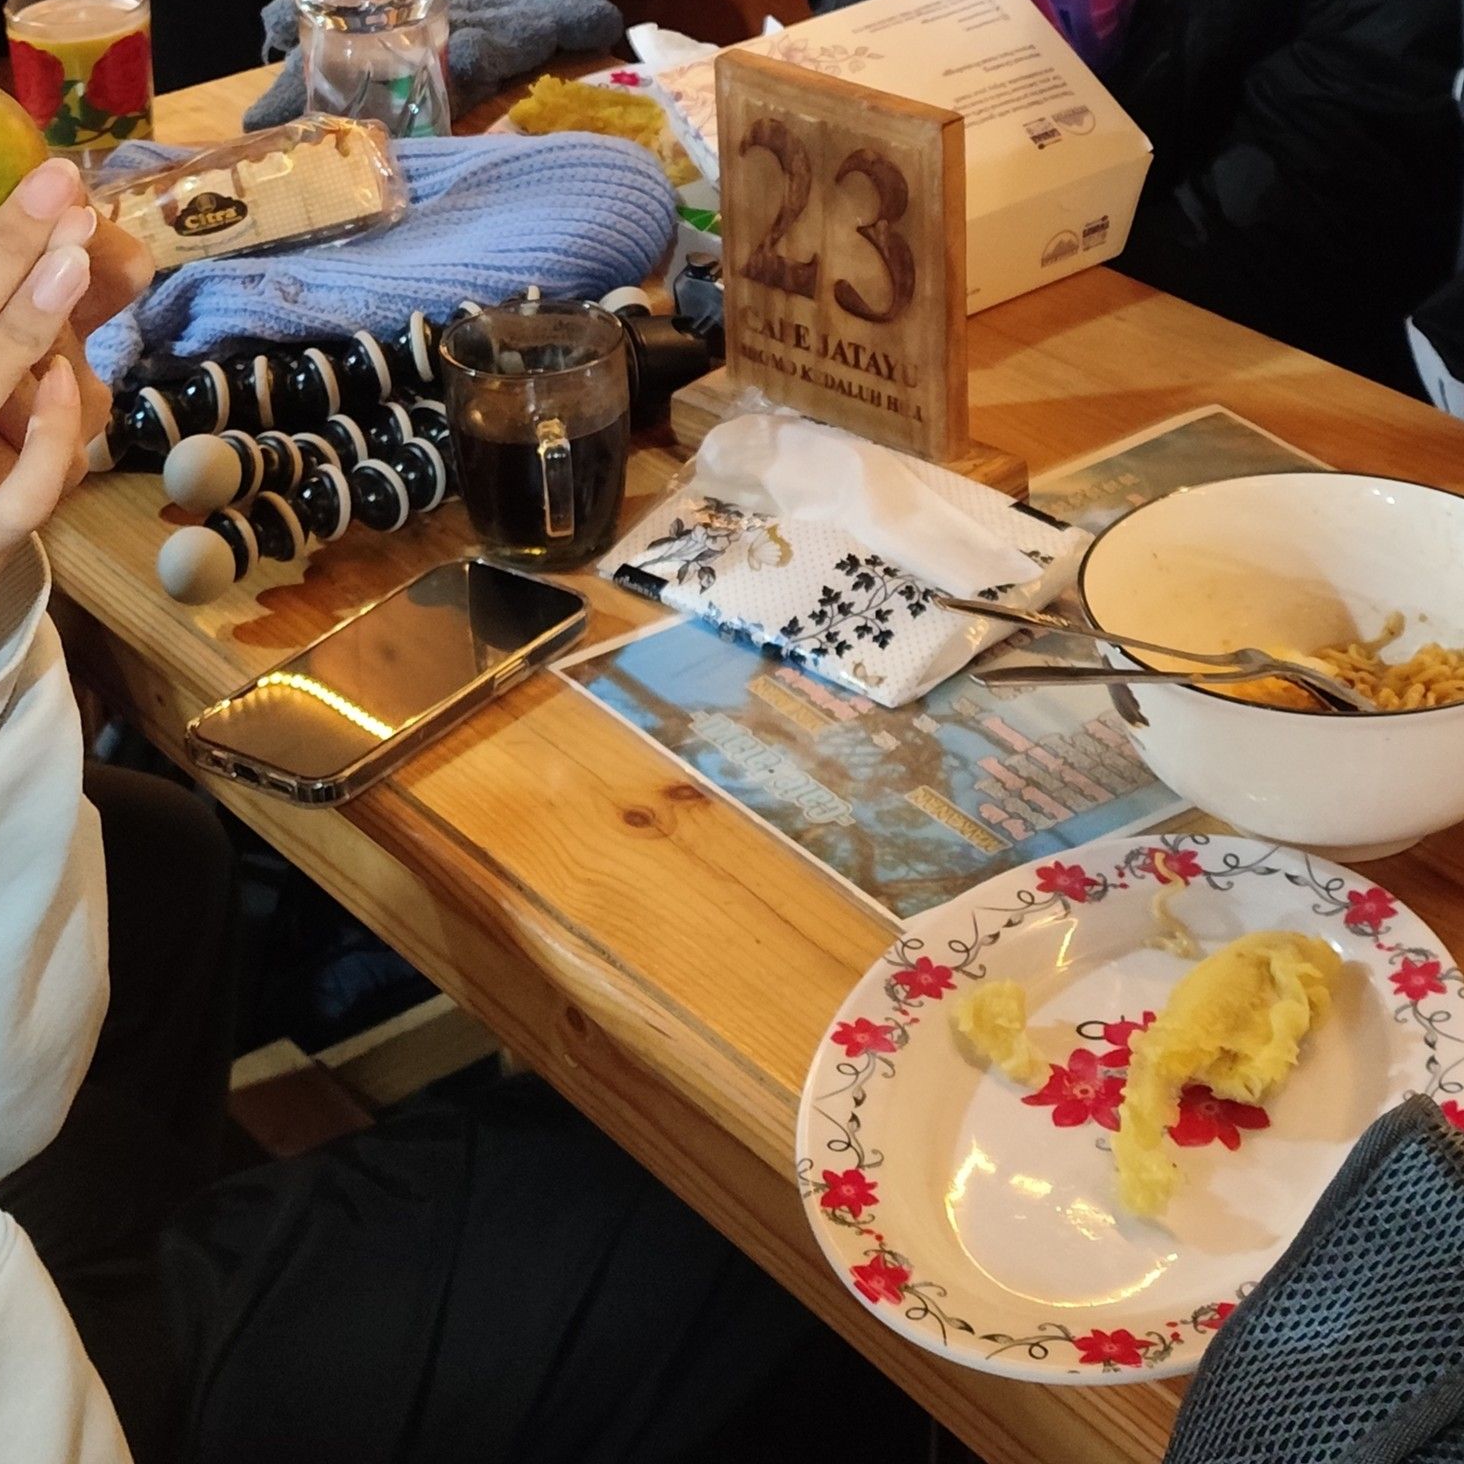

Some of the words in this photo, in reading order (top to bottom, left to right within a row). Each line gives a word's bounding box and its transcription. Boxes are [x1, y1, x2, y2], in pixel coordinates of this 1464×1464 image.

[184, 207, 237, 230] Citra
[739, 117, 917, 324] 23
[740, 305, 811, 351] CAFE
[816, 334, 919, 388] JATAYU
